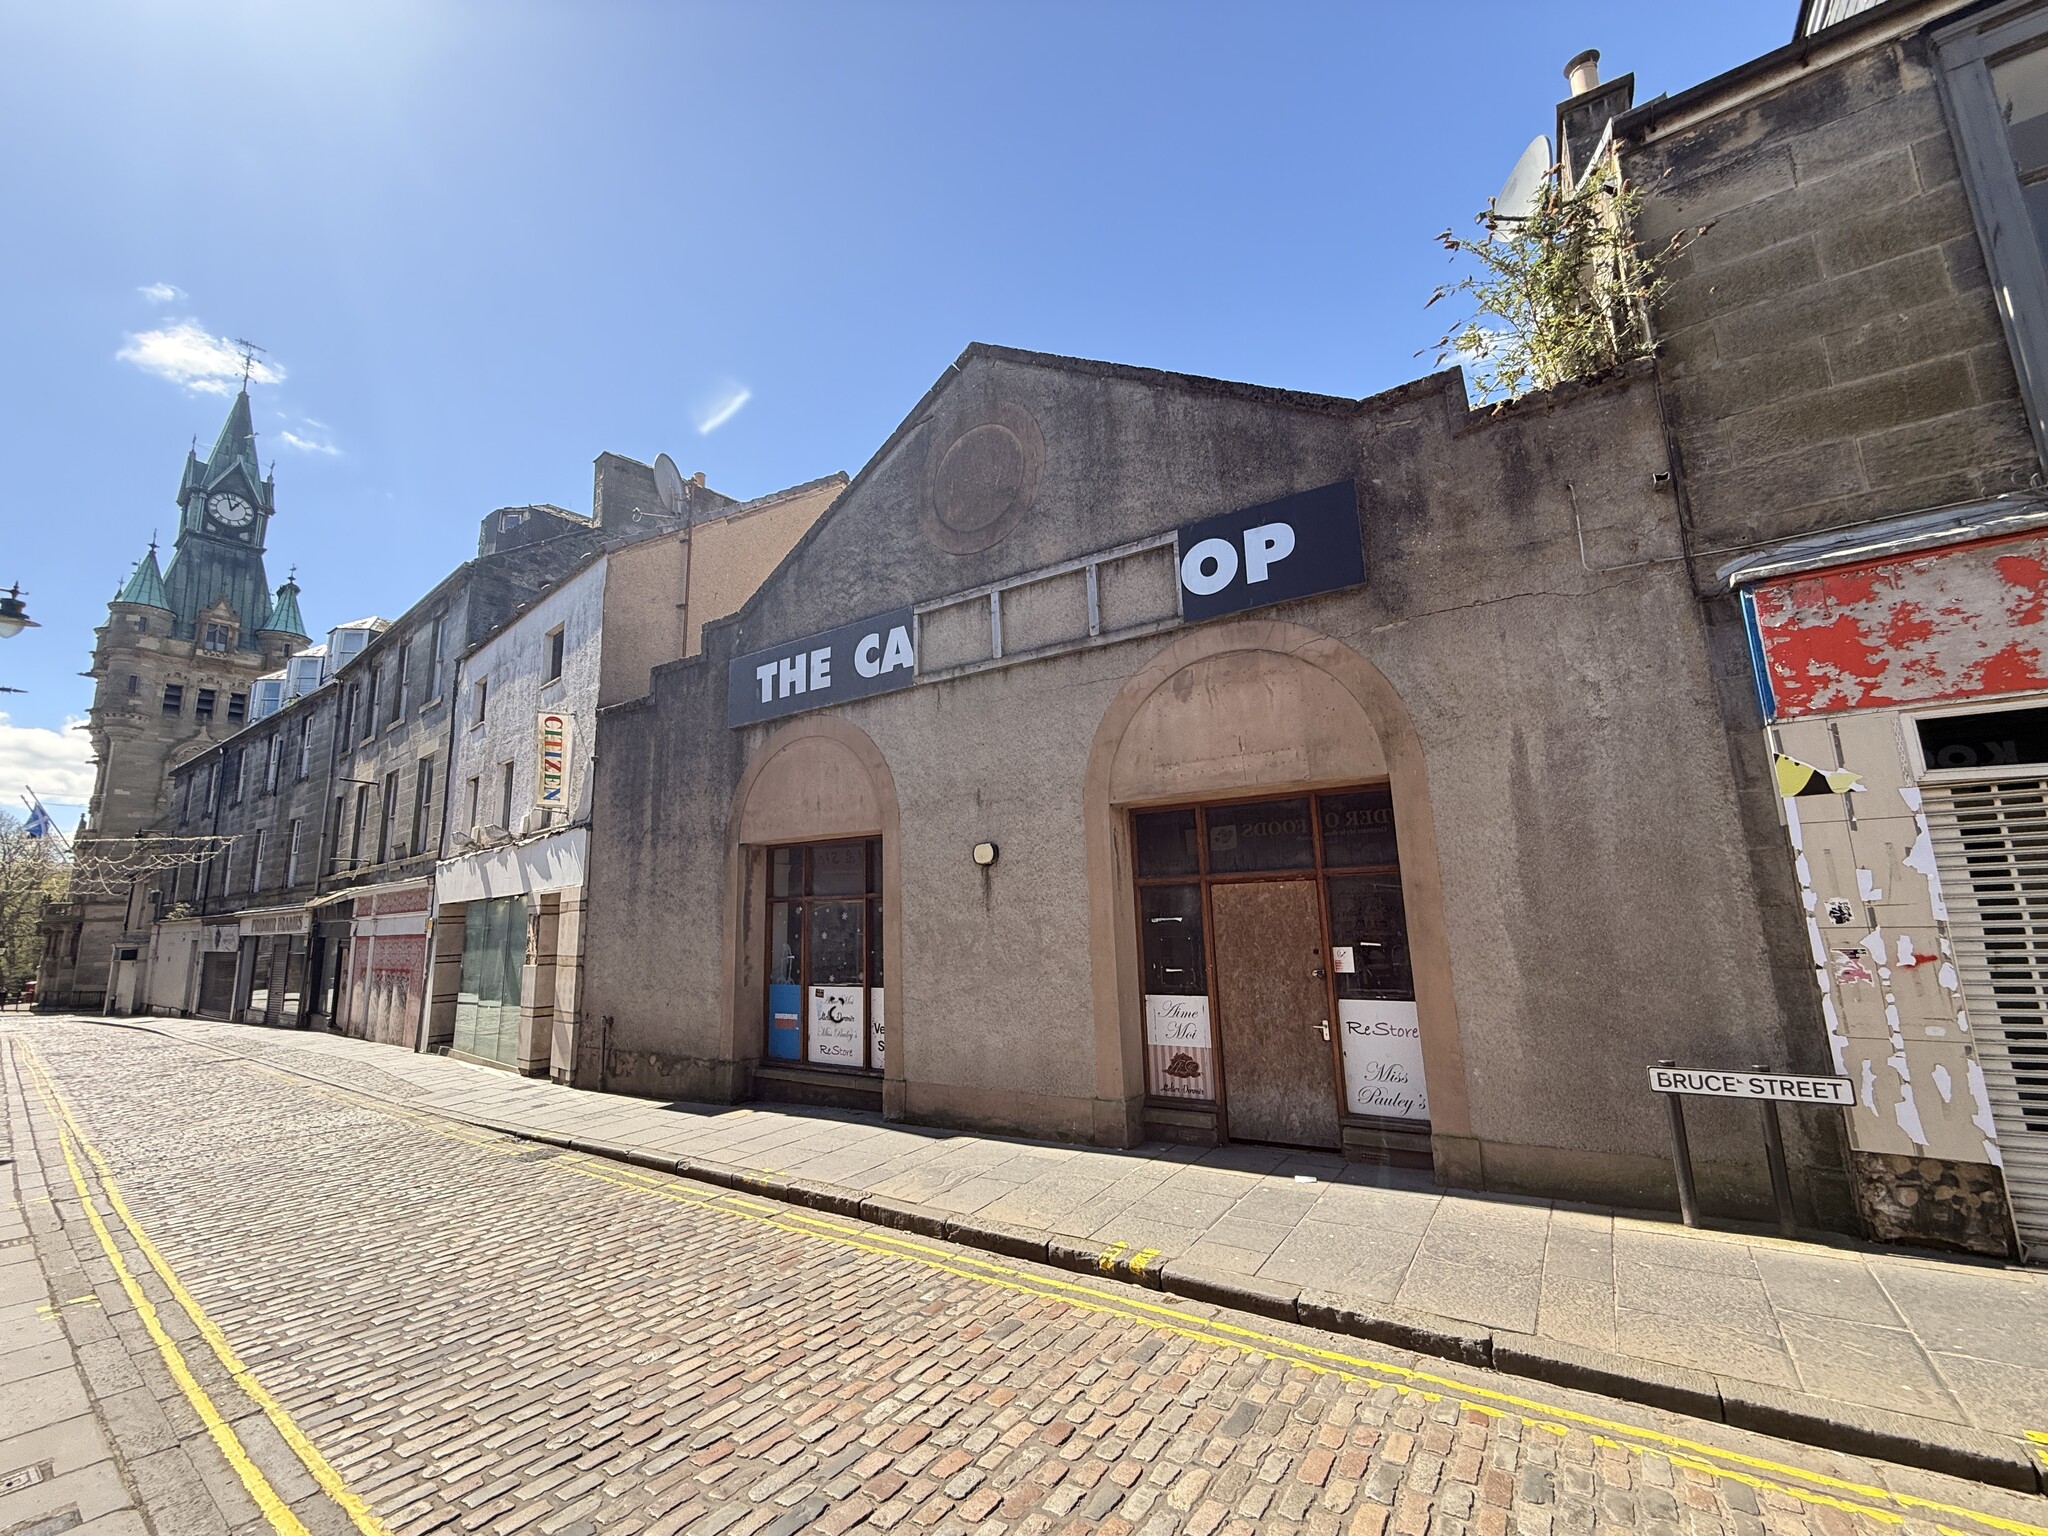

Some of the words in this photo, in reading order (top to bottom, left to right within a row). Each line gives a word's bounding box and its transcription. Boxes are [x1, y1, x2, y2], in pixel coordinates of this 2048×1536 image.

[1180, 521, 1296, 597] OP
[756, 646, 832, 703] THE
[853, 625, 914, 680] CA
[542, 716, 563, 803] CITIZEN
[1157, 999, 1199, 1020] Aime
[1165, 1020, 1198, 1040] Moi
[1345, 1020, 1420, 1039] ReStore
[819, 1044, 854, 1057] ReStore
[1364, 1060, 1409, 1085] Miss
[1657, 1071, 1738, 1093] BRUCE
[1749, 1077, 1842, 1100] STREET
[1358, 1085, 1427, 1116] Pauley's
